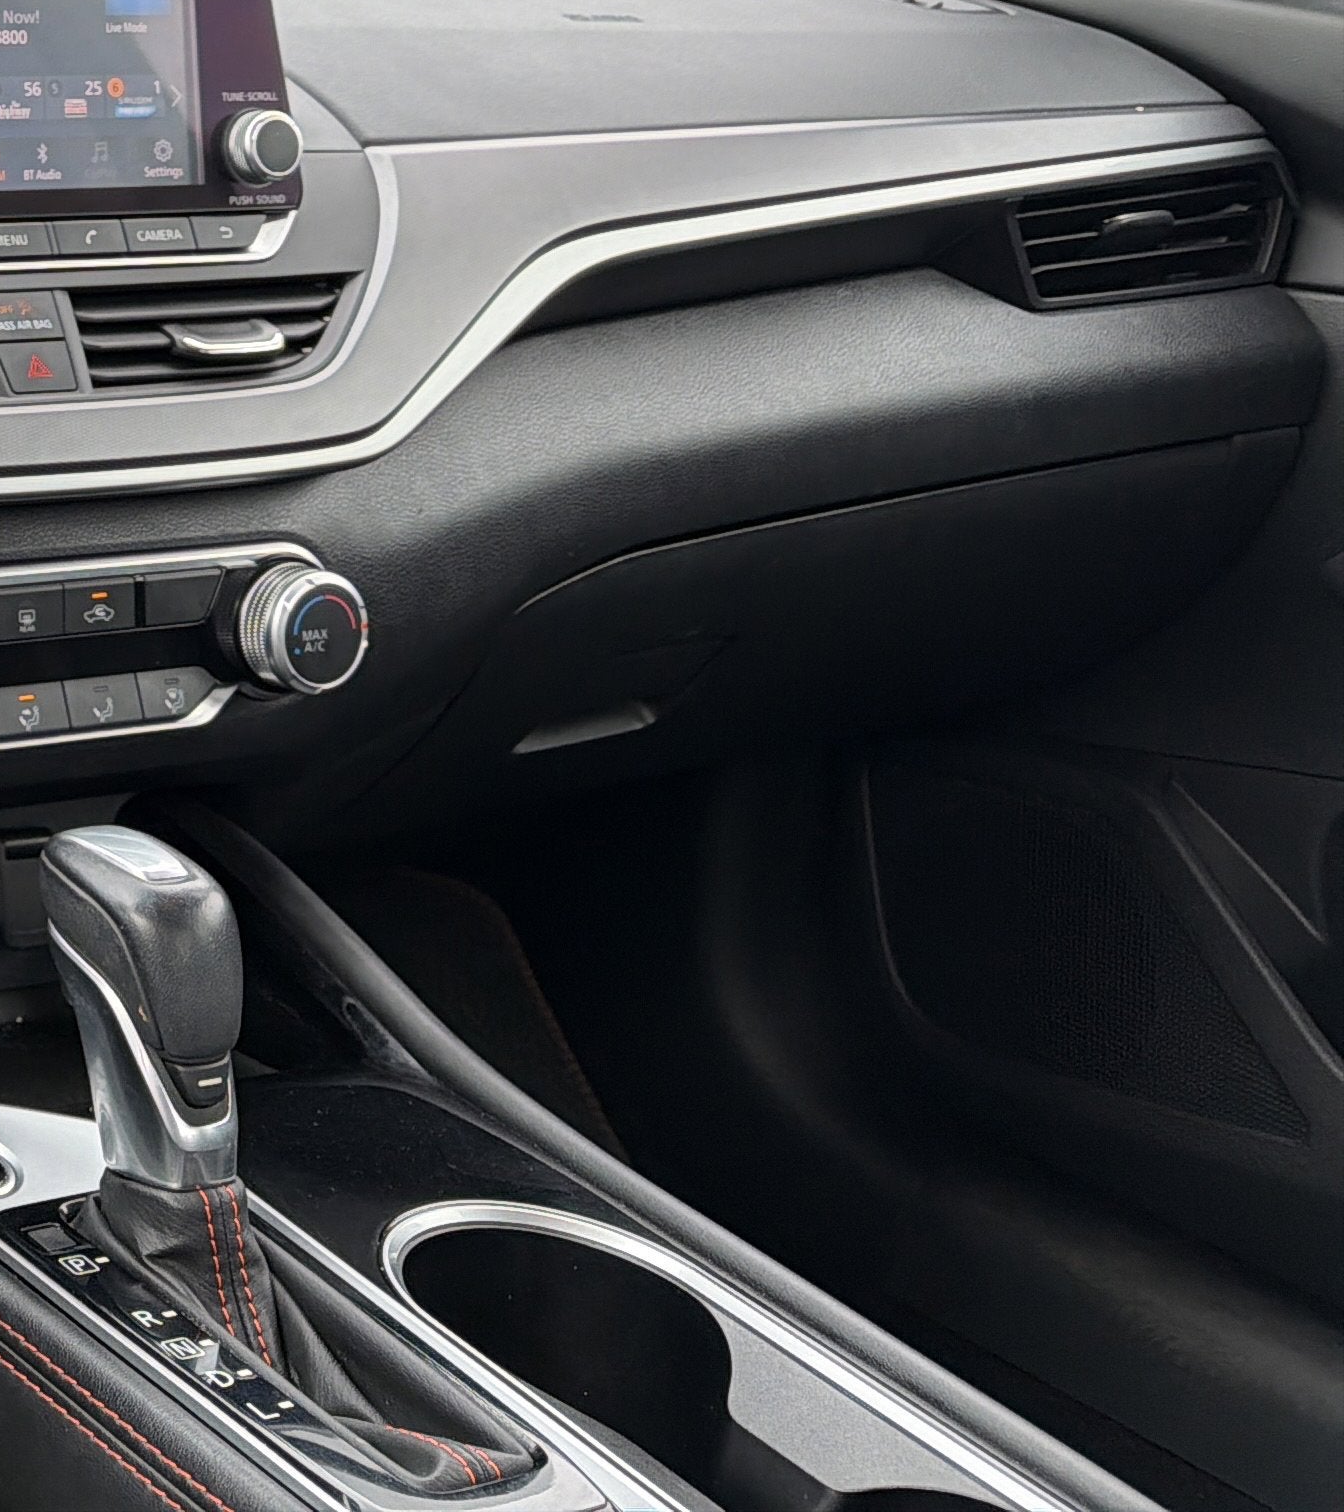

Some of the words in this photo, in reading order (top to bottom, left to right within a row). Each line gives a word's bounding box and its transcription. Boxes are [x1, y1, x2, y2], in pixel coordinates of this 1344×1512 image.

[3, 9, 40, 25] Now!
[23, 81, 42, 97] 56
[85, 81, 103, 96] 25
[153, 81, 161, 95] 1
[24, 170, 34, 181] BT
[35, 169, 62, 181] Audio
[144, 166, 184, 179] Settings
[228, 195, 254, 206] PUSH
[256, 194, 286, 205] SOUND
[136, 228, 183, 242] CAMERA
[17, 319, 33, 330] AIR
[33, 318, 53, 330] BAG
[301, 628, 329, 641] MAX
[304, 640, 326, 653] A/C
[69, 1258, 86, 1272] P
[132, 1310, 163, 1327] R
[172, 1341, 194, 1357] N
[205, 1369, 234, 1388] D
[246, 1402, 281, 1420] L
